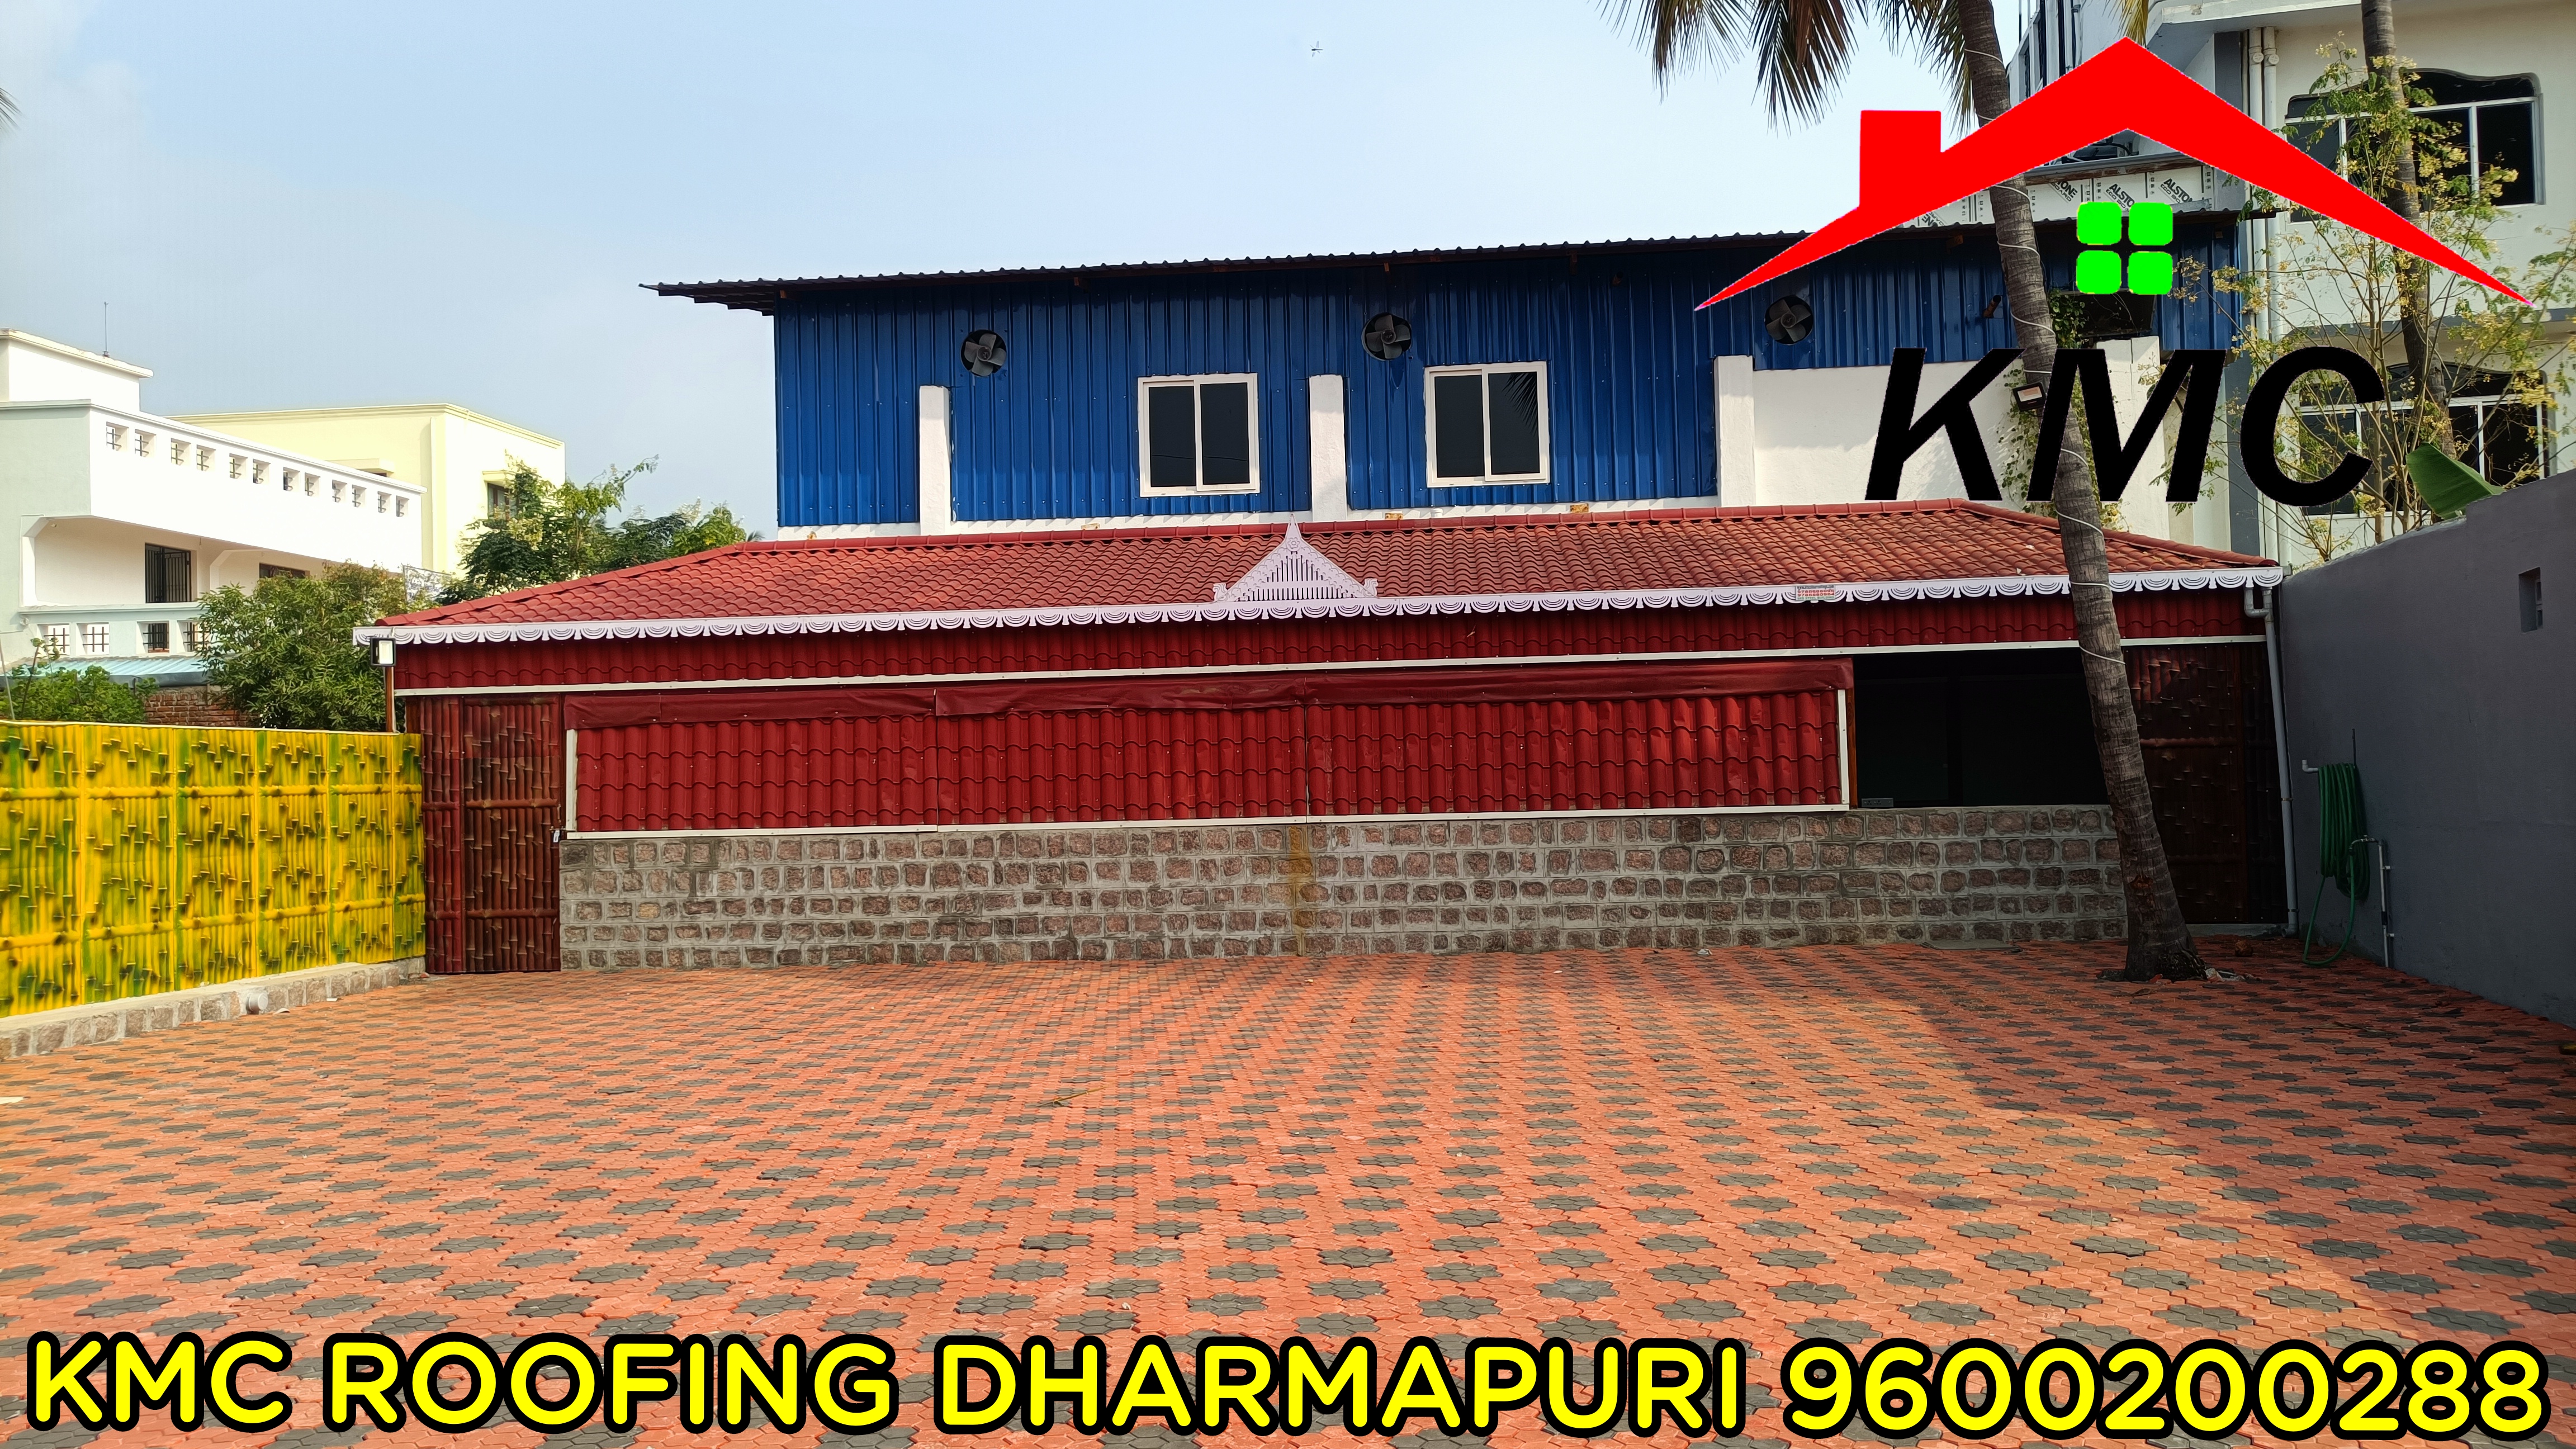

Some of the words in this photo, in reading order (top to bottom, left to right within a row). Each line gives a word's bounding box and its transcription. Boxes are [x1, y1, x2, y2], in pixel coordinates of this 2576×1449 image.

[2106, 189, 2116, 200] ECO
[2109, 183, 2135, 207] ALSTO
[2160, 183, 2172, 195] ECO
